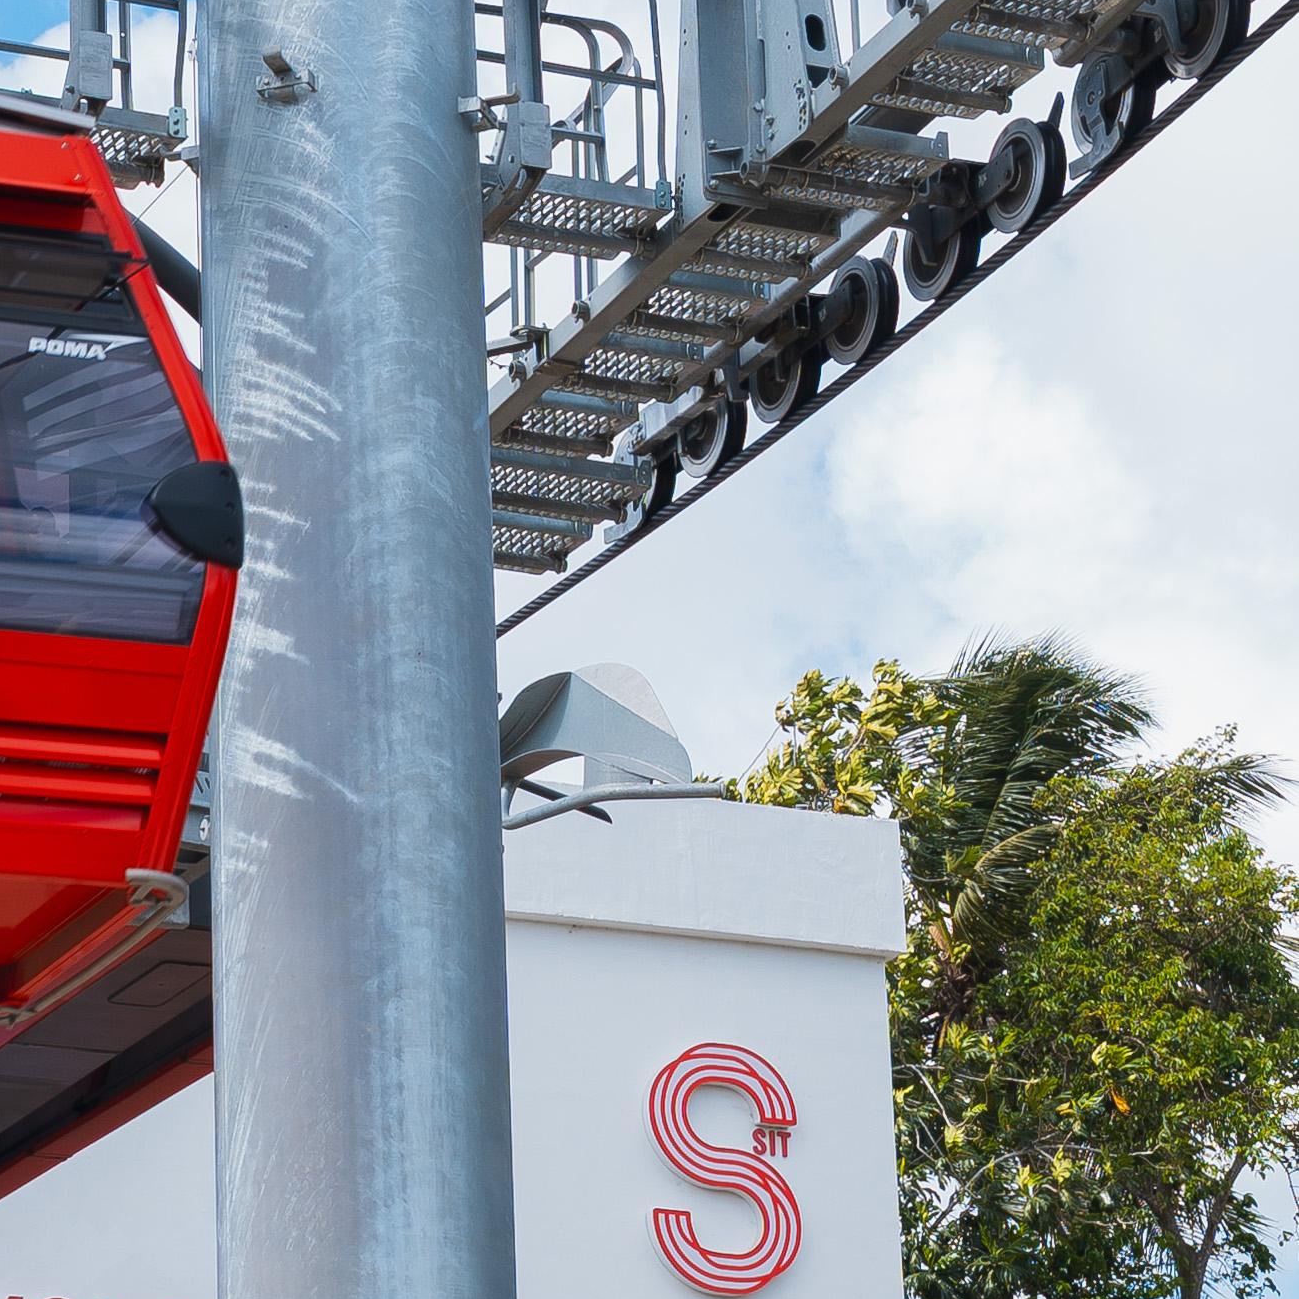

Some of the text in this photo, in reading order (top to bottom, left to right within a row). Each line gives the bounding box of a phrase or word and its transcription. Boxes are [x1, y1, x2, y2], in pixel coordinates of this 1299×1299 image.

[28, 336, 106, 361] POMA
[752, 1128, 792, 1158] SIT
[646, 1042, 803, 1295] S
